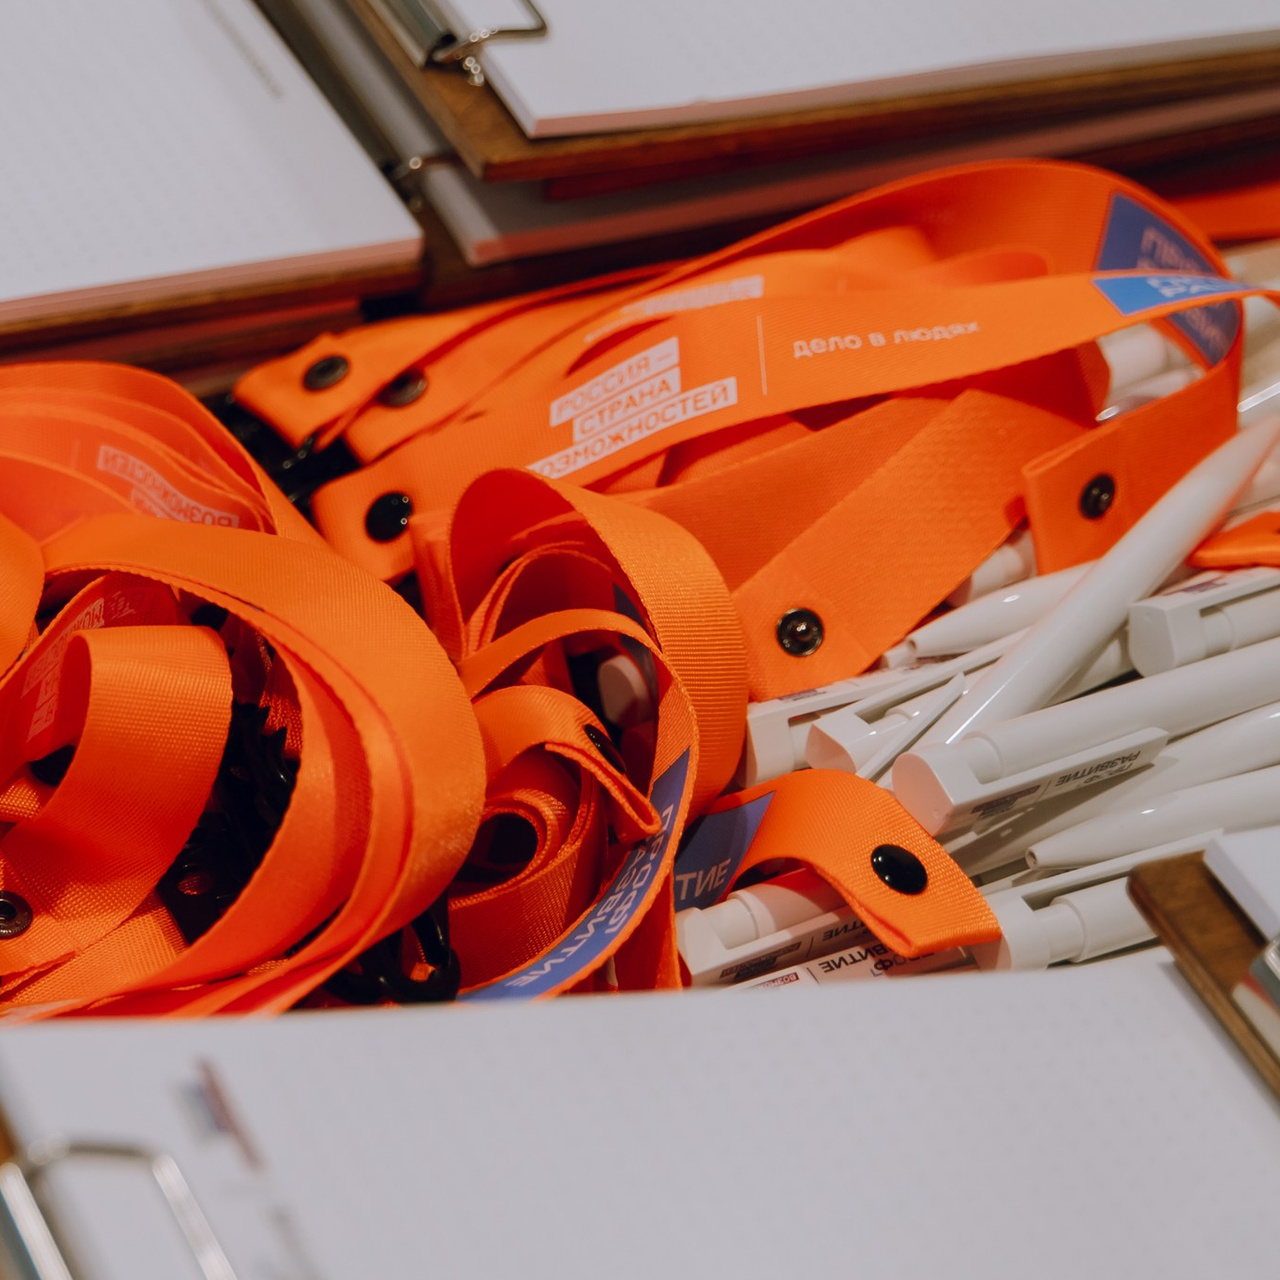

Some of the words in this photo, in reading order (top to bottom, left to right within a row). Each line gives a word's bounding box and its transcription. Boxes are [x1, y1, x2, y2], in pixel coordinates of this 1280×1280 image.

[793, 334, 863, 359] дело
[868, 331, 887, 348] в
[552, 355, 651, 421] РОССИЯ
[577, 378, 673, 437] СТРАНА
[532, 383, 730, 477] ОЗМОЖНОСТЕЙ
[1055, 750, 1141, 787] РАЗВИТИЕ
[504, 848, 647, 988] АЗВИТИЕ
[818, 943, 889, 974] ВИТИЕ
